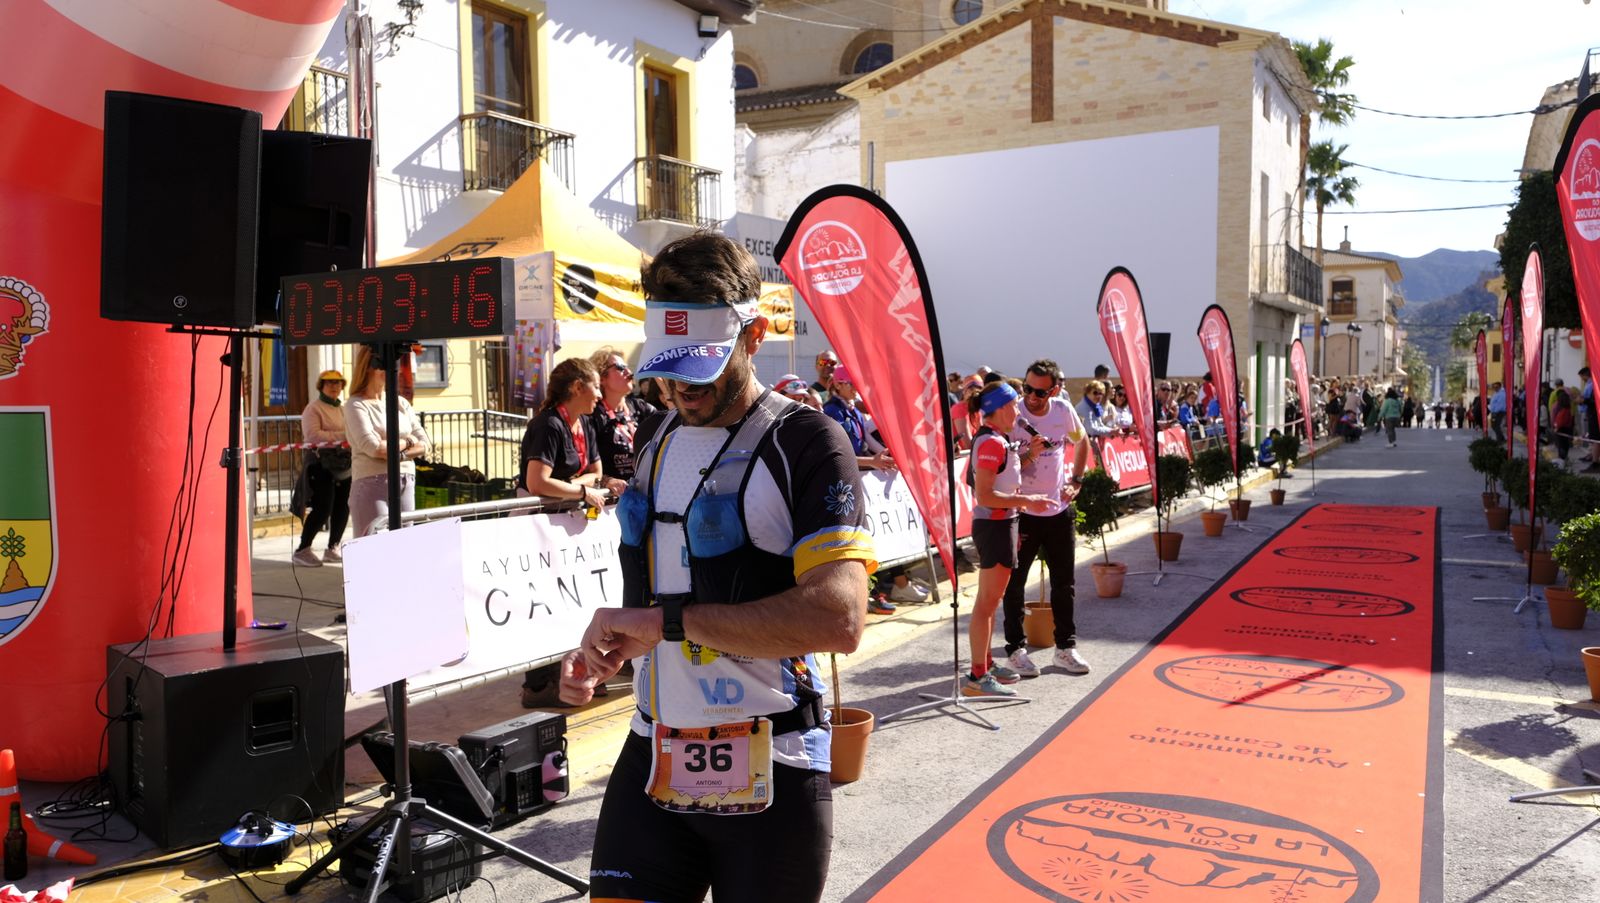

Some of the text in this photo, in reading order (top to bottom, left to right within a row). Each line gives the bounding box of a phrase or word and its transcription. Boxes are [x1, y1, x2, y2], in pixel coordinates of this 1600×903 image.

[642, 346, 724, 370] COMPRESS
[1128, 733, 1349, 770] Ayuntamiento
[1154, 726, 1333, 756] de Cantoria
[684, 743, 733, 772] 36
[1090, 799, 1186, 821] Cantoria
[1062, 802, 1330, 857] LA POLVORA
[371, 833, 393, 874] VONYX
